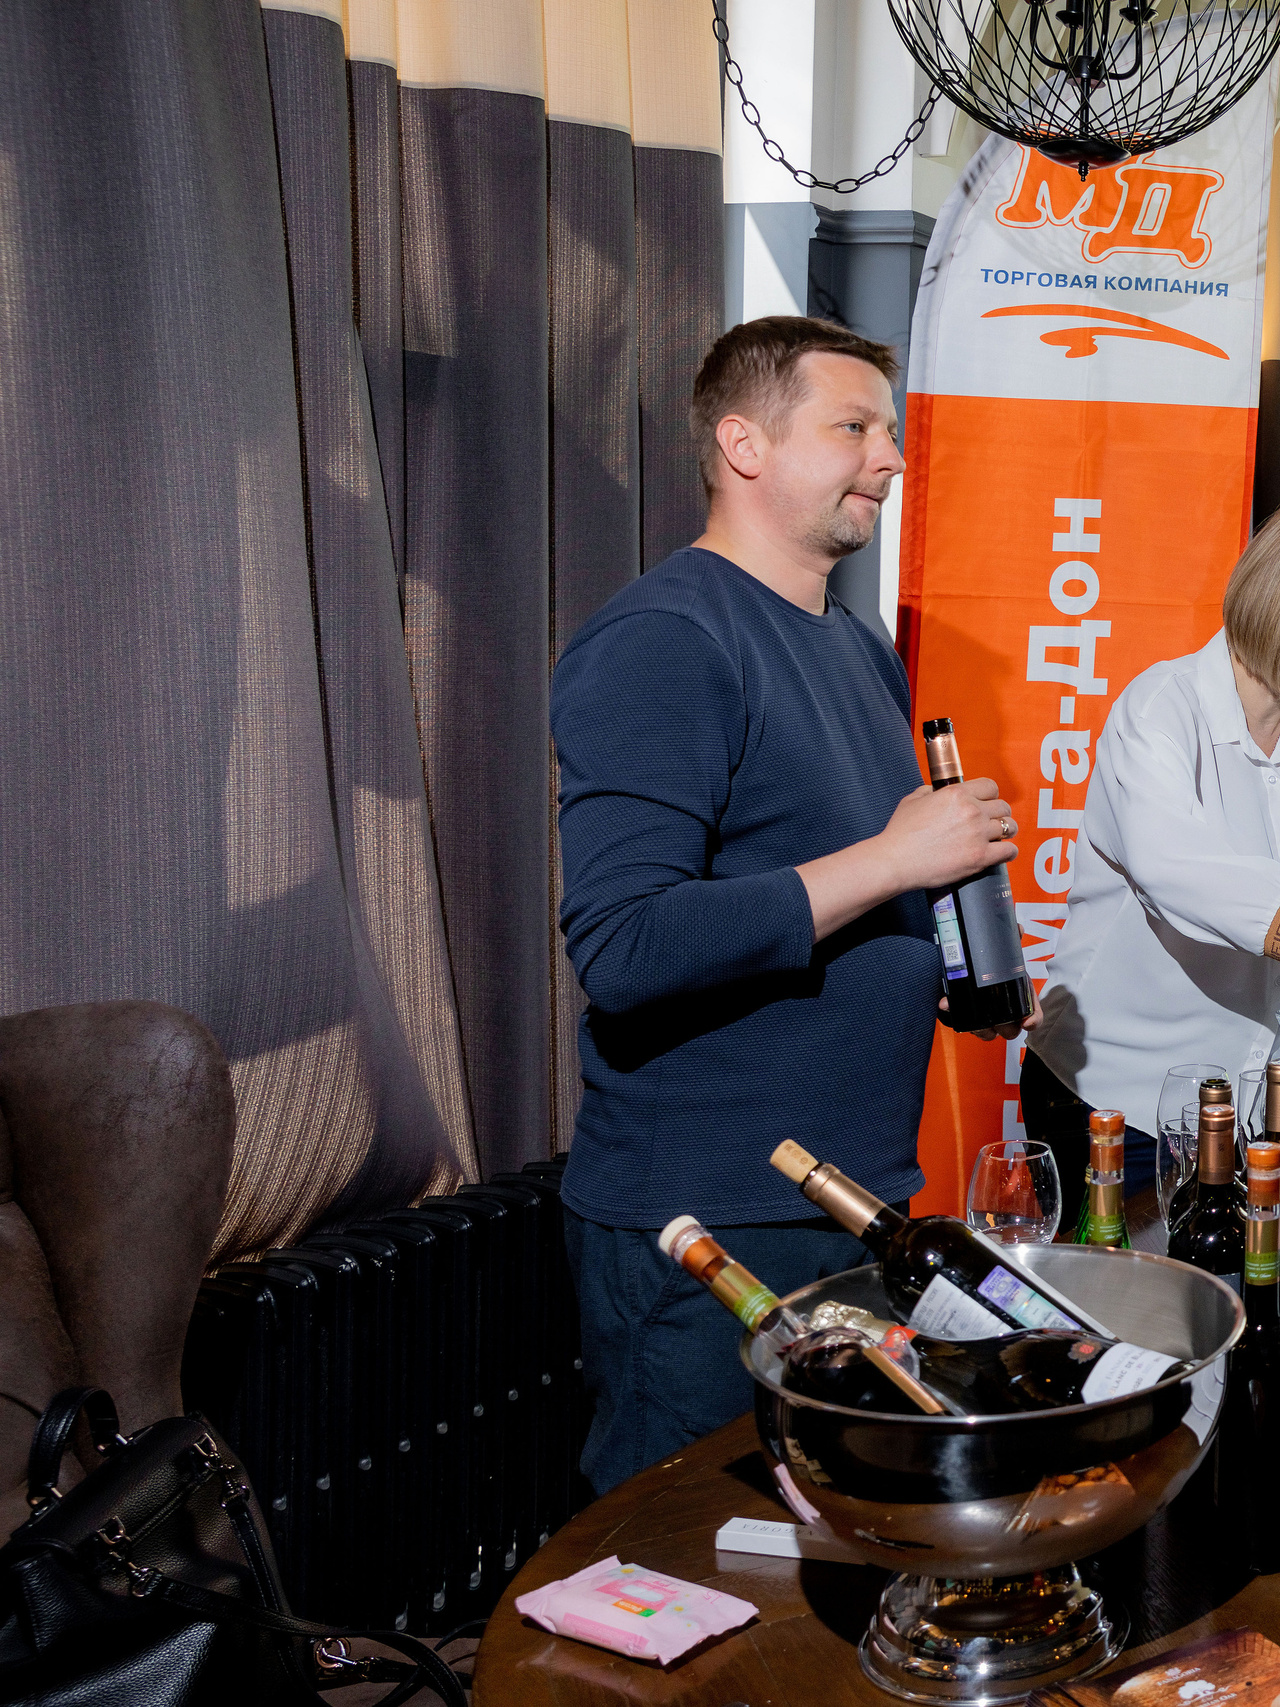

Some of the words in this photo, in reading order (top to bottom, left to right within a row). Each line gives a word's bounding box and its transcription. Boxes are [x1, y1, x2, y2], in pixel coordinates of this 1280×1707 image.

[995, 124, 1226, 270] МД
[980, 268, 1098, 290] ТОРГОВАЯ
[1104, 274, 1230, 297] КОМПАНИЯ
[1015, 497, 1112, 1001] Мега-Дон
